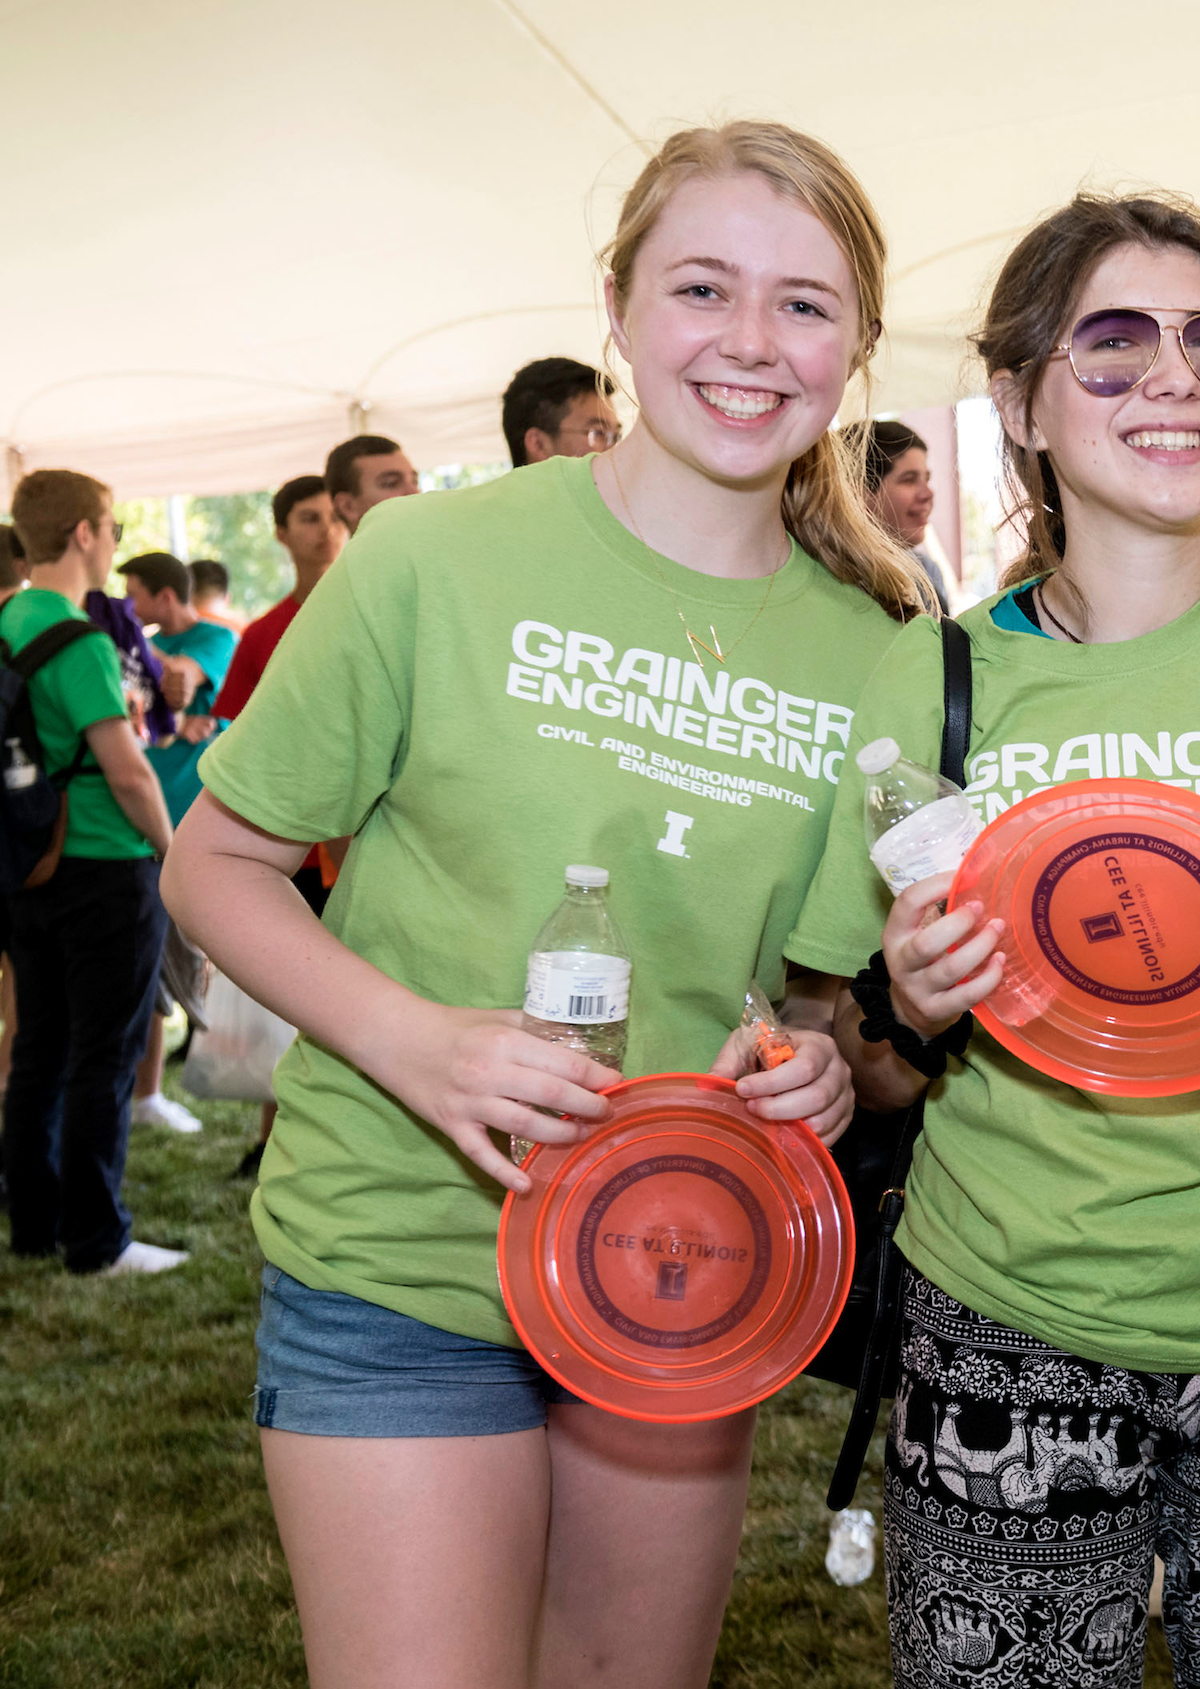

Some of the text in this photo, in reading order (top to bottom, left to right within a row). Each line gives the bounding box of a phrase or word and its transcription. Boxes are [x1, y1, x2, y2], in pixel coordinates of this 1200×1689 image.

[511, 620, 855, 748] GRAINGER
[537, 723, 816, 812] CIVIL AND ENVIRONMENTAL
[618, 754, 753, 807] ENGINEERING
